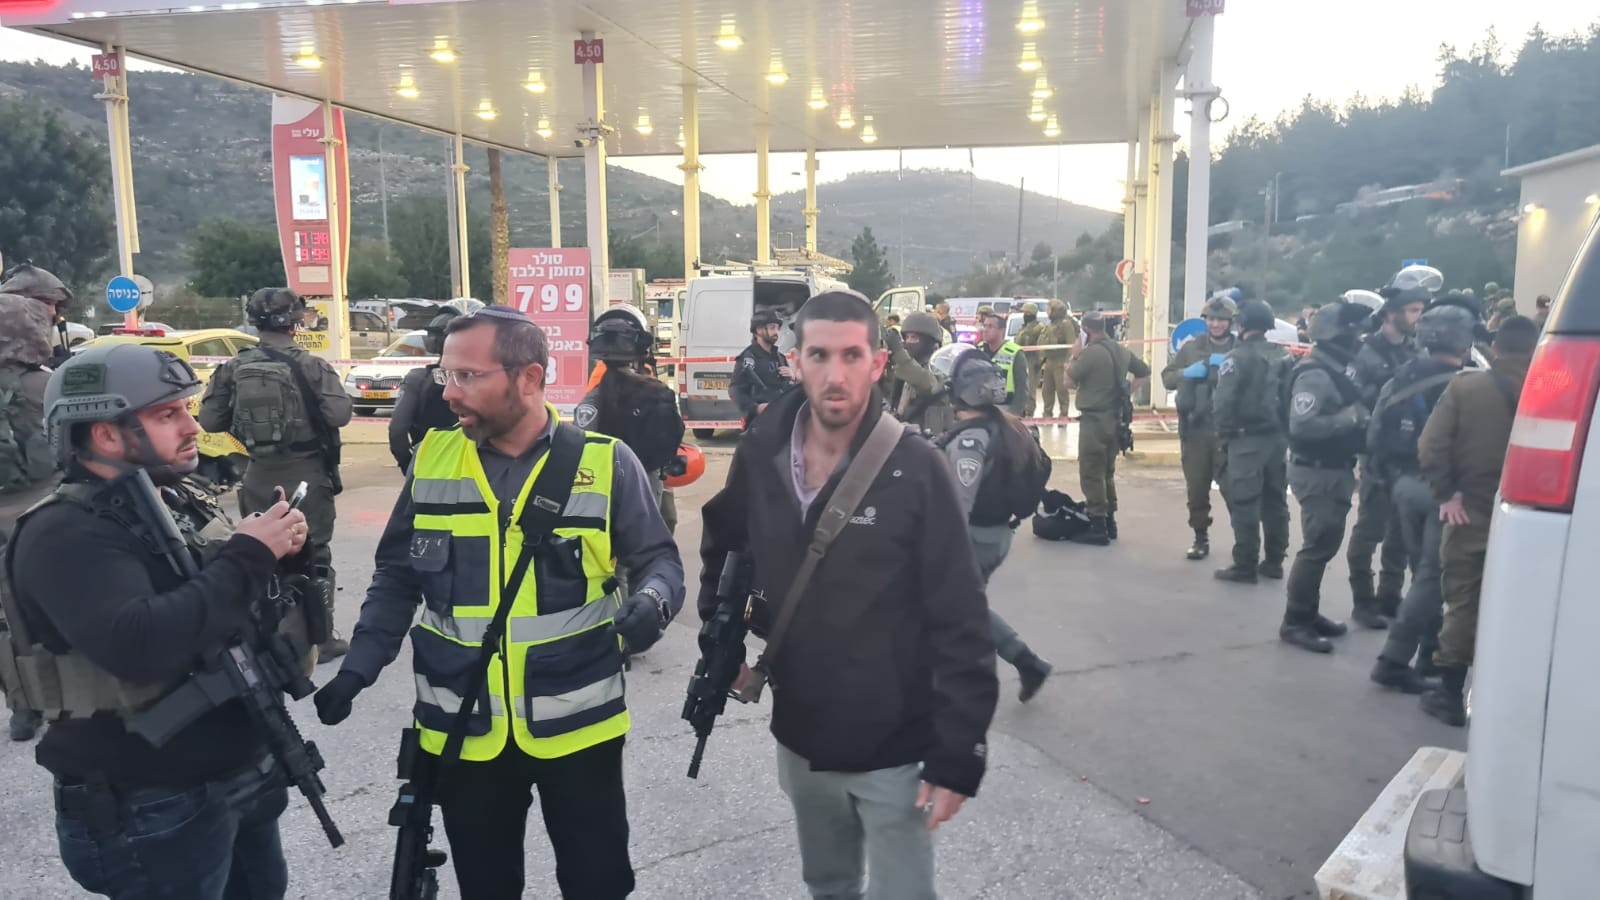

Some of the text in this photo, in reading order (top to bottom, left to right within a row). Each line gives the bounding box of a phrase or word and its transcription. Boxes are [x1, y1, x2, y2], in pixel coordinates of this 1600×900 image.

[576, 45, 602, 57] 4.50
[94, 58, 117, 70] 4.50
[532, 252, 563, 265] סולר
[509, 264, 585, 280] מזומן בלבד
[108, 288, 139, 299] כניסה
[547, 338, 583, 351] באפל
